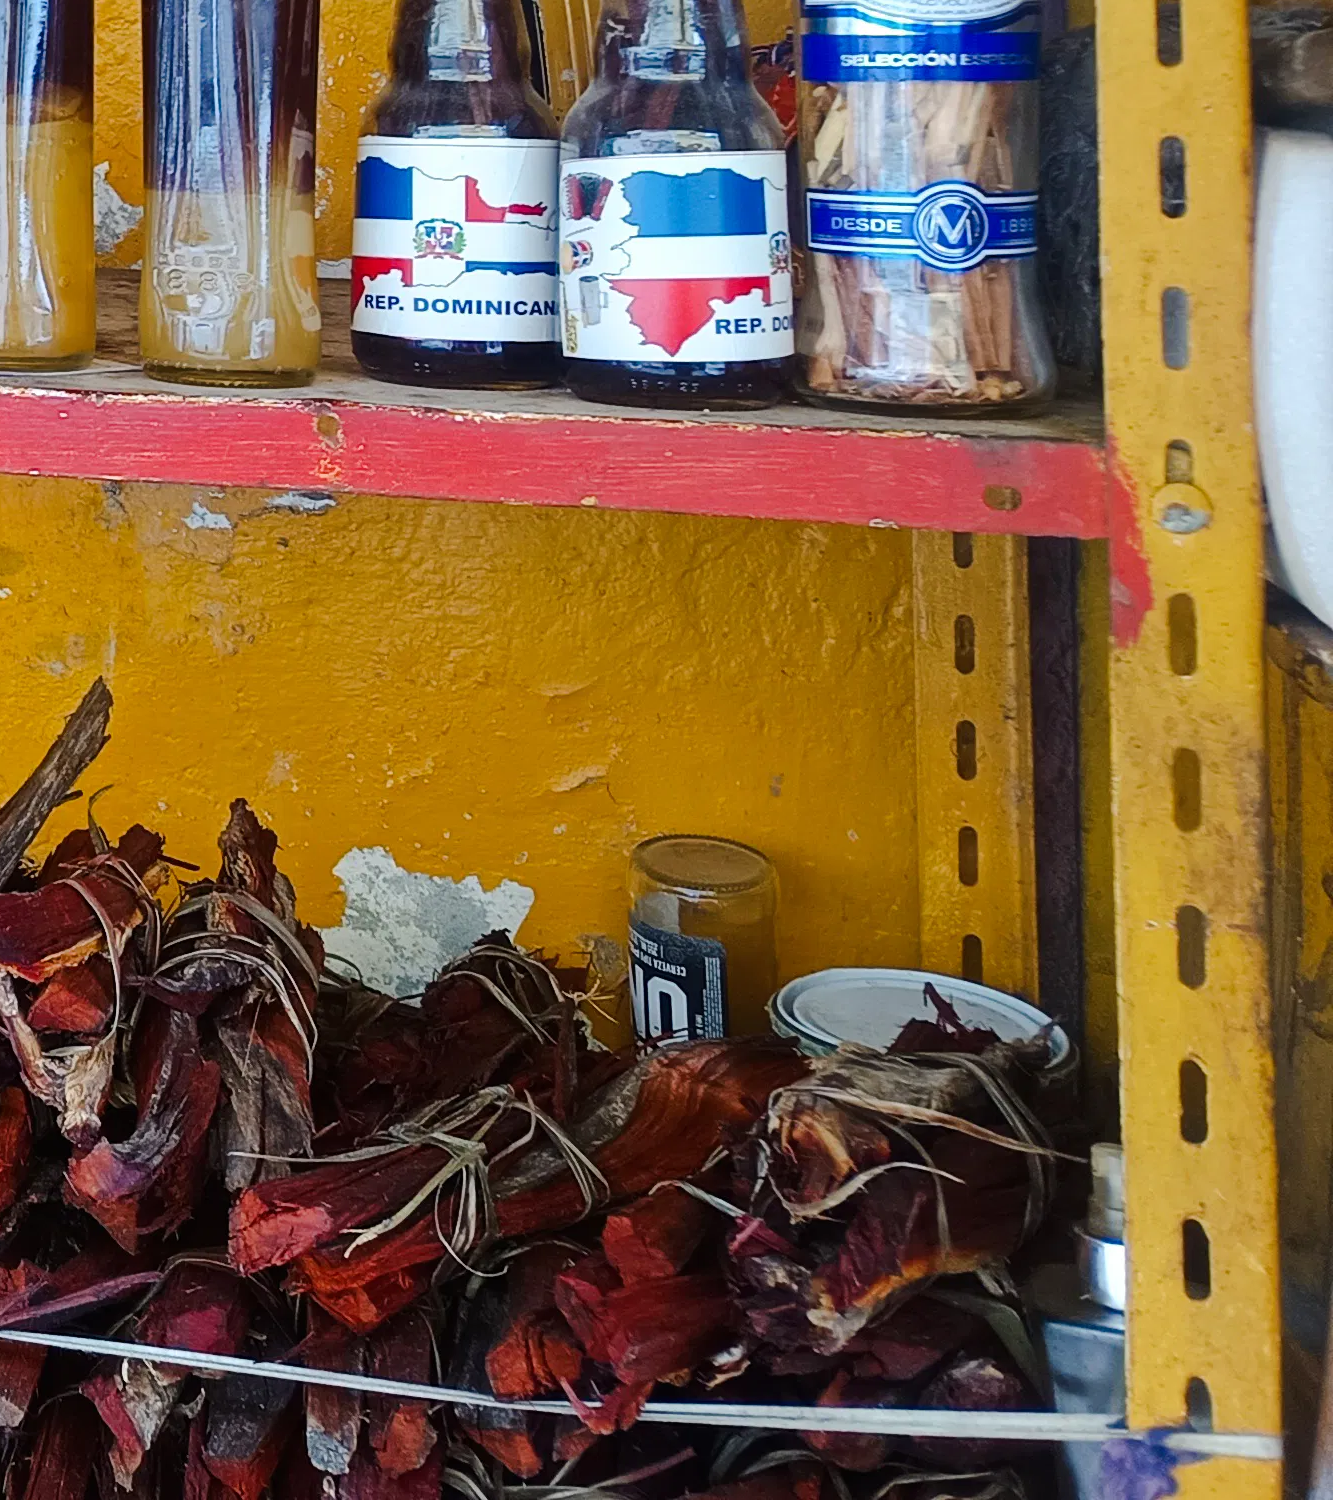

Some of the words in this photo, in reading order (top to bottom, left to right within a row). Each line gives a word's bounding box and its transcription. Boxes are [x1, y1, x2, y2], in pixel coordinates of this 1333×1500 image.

[840, 49, 958, 68] SELECCIÓN
[831, 215, 902, 234] DESDE
[364, 293, 405, 312] REP.
[715, 318, 767, 336] REP.
[772, 316, 794, 333] DO
